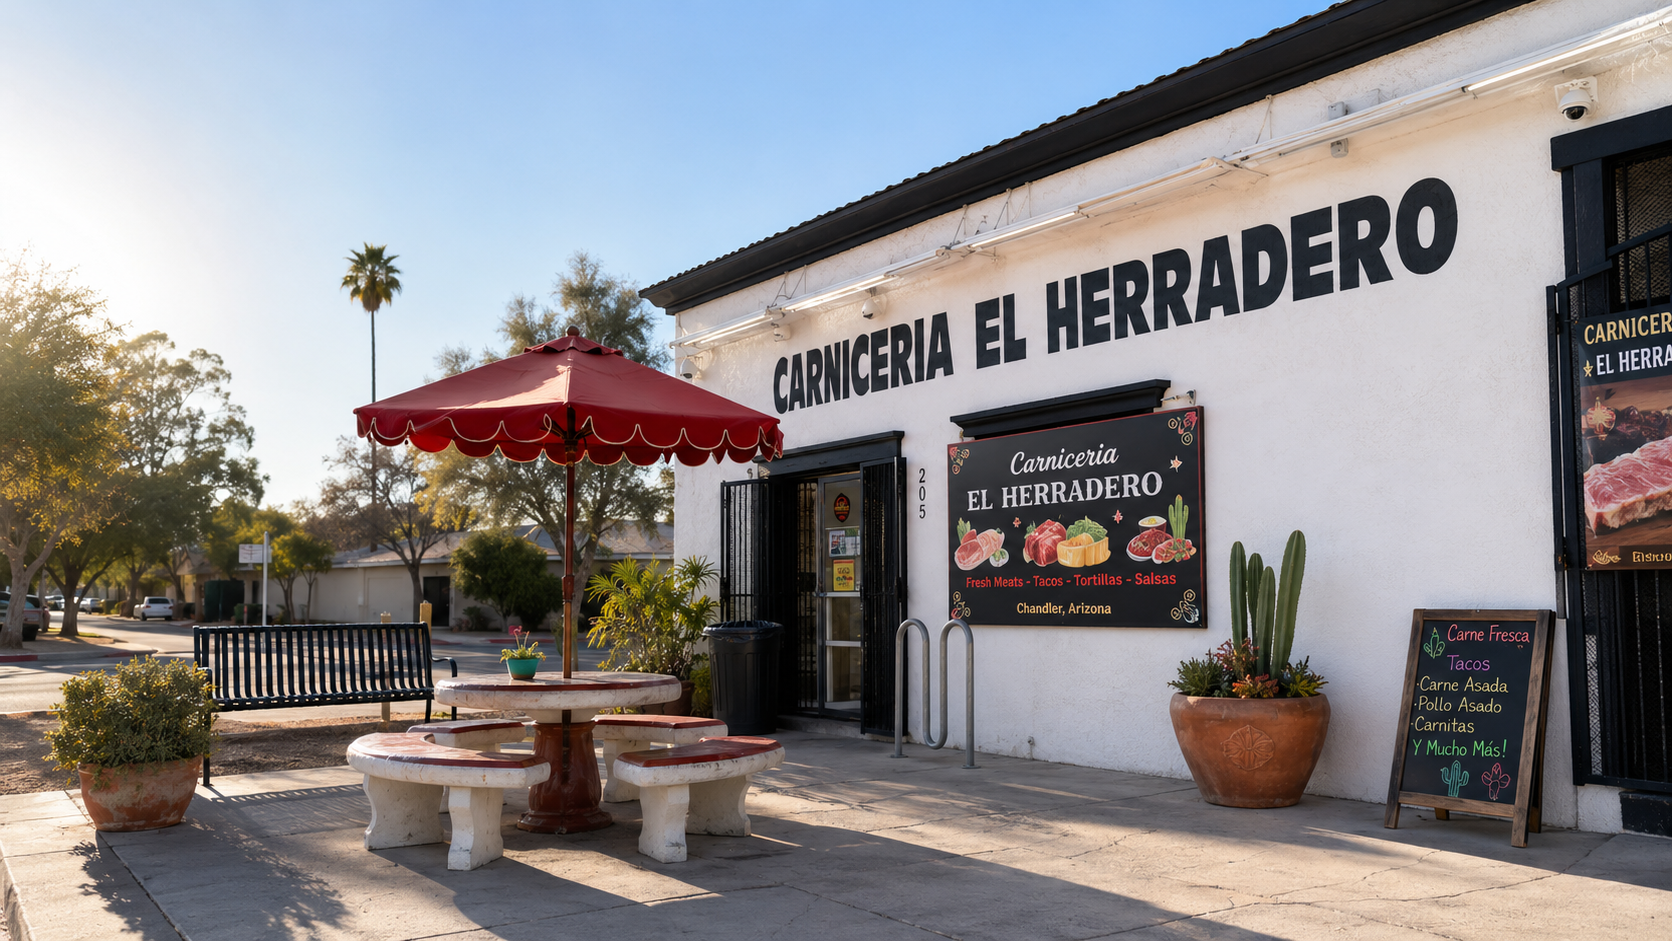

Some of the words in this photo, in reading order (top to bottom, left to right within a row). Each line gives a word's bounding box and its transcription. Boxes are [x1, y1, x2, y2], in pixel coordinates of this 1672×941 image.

[773, 312, 953, 415] CARNICERIA
[975, 293, 1027, 369] EL
[1046, 177, 1458, 354] HERRADERO
[1584, 311, 1672, 345] CARNICER
[1596, 353, 1614, 375] EL
[1010, 443, 1119, 476] Carniceria
[967, 489, 993, 511] EL
[1001, 471, 1163, 509] HERRADERO
[966, 576, 991, 588] Fresh
[994, 576, 1023, 587] Meats
[1033, 575, 1063, 587] Tacos
[1074, 574, 1122, 586] Tortillas
[1135, 572, 1176, 585] Salsas
[1017, 602, 1065, 616] Chandler,
[1068, 602, 1111, 614] Arizona
[1447, 623, 1484, 642] Carne
[1447, 654, 1490, 671] Tacos
[1419, 675, 1459, 692] Carne
[1464, 676, 1509, 693] Asada
[1418, 695, 1452, 712] Pollo
[1458, 696, 1502, 714] Asado
[1414, 715, 1475, 733] Carnitas
[1412, 738, 1422, 756] Y
[1426, 739, 1467, 757] Mucho
[1472, 739, 1507, 758] Más!
